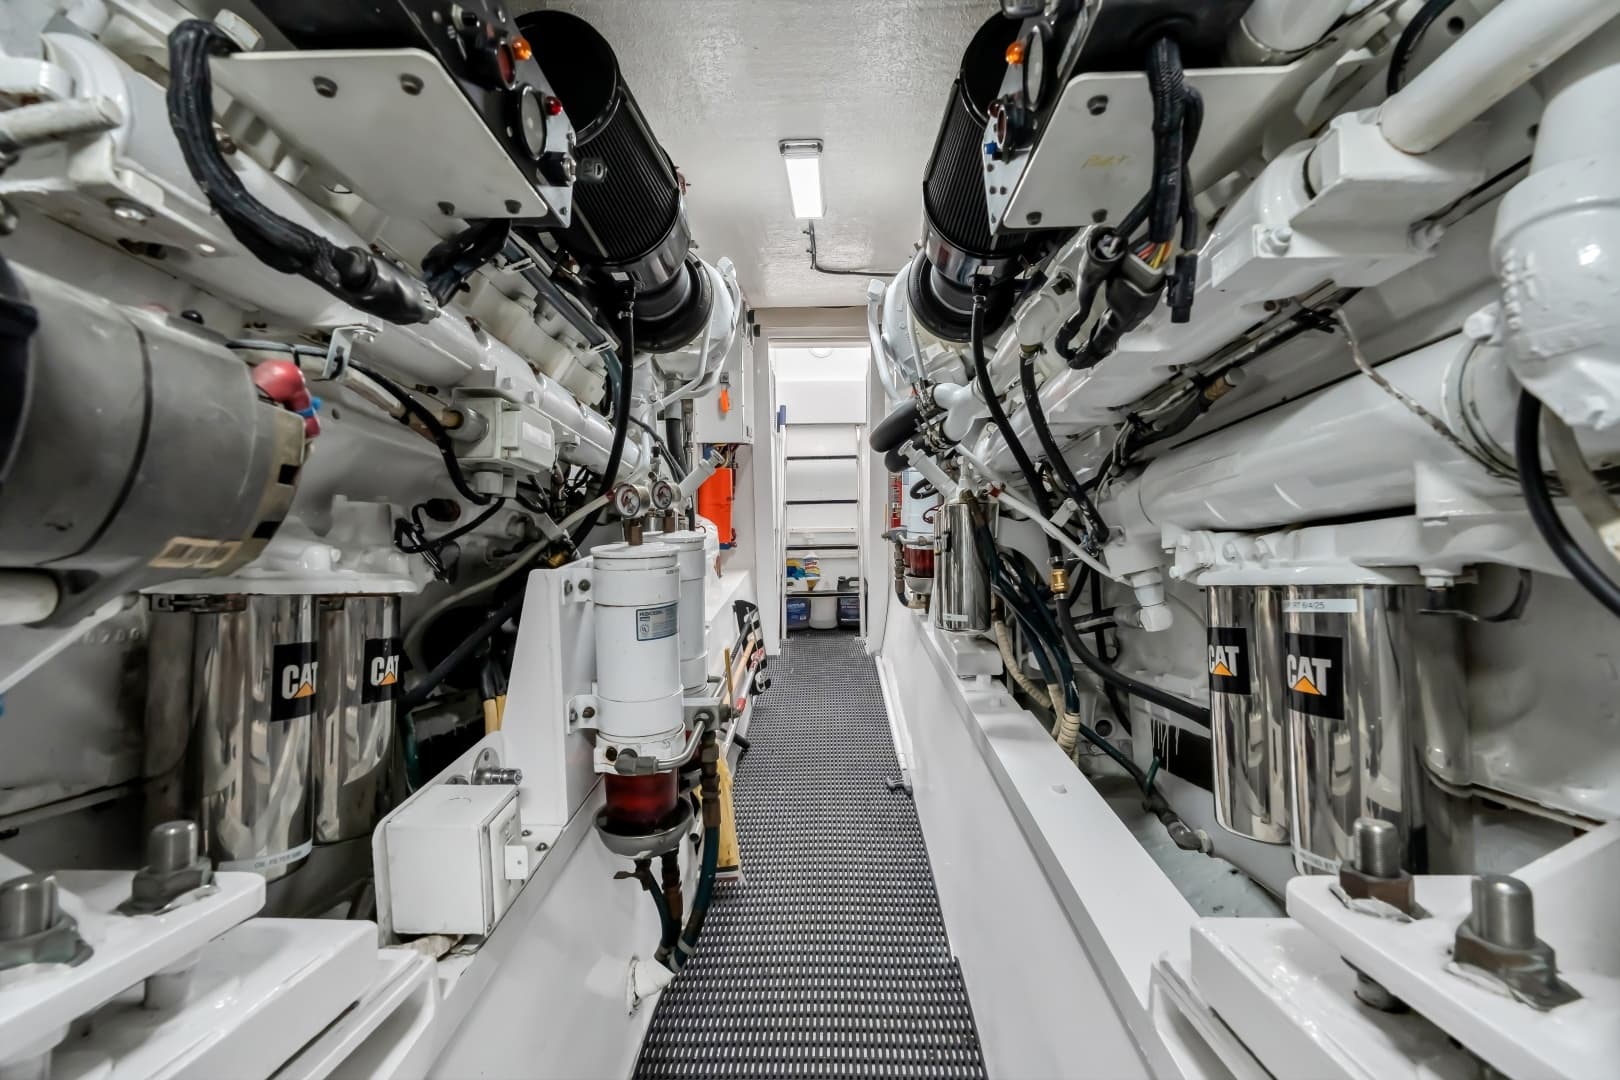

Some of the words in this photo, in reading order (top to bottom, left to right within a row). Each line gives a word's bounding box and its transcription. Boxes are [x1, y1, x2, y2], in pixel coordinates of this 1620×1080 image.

[370, 654, 400, 686] CAT
[1208, 644, 1240, 677] CAT
[1286, 654, 1332, 697] CAT
[281, 661, 319, 700] CAT
